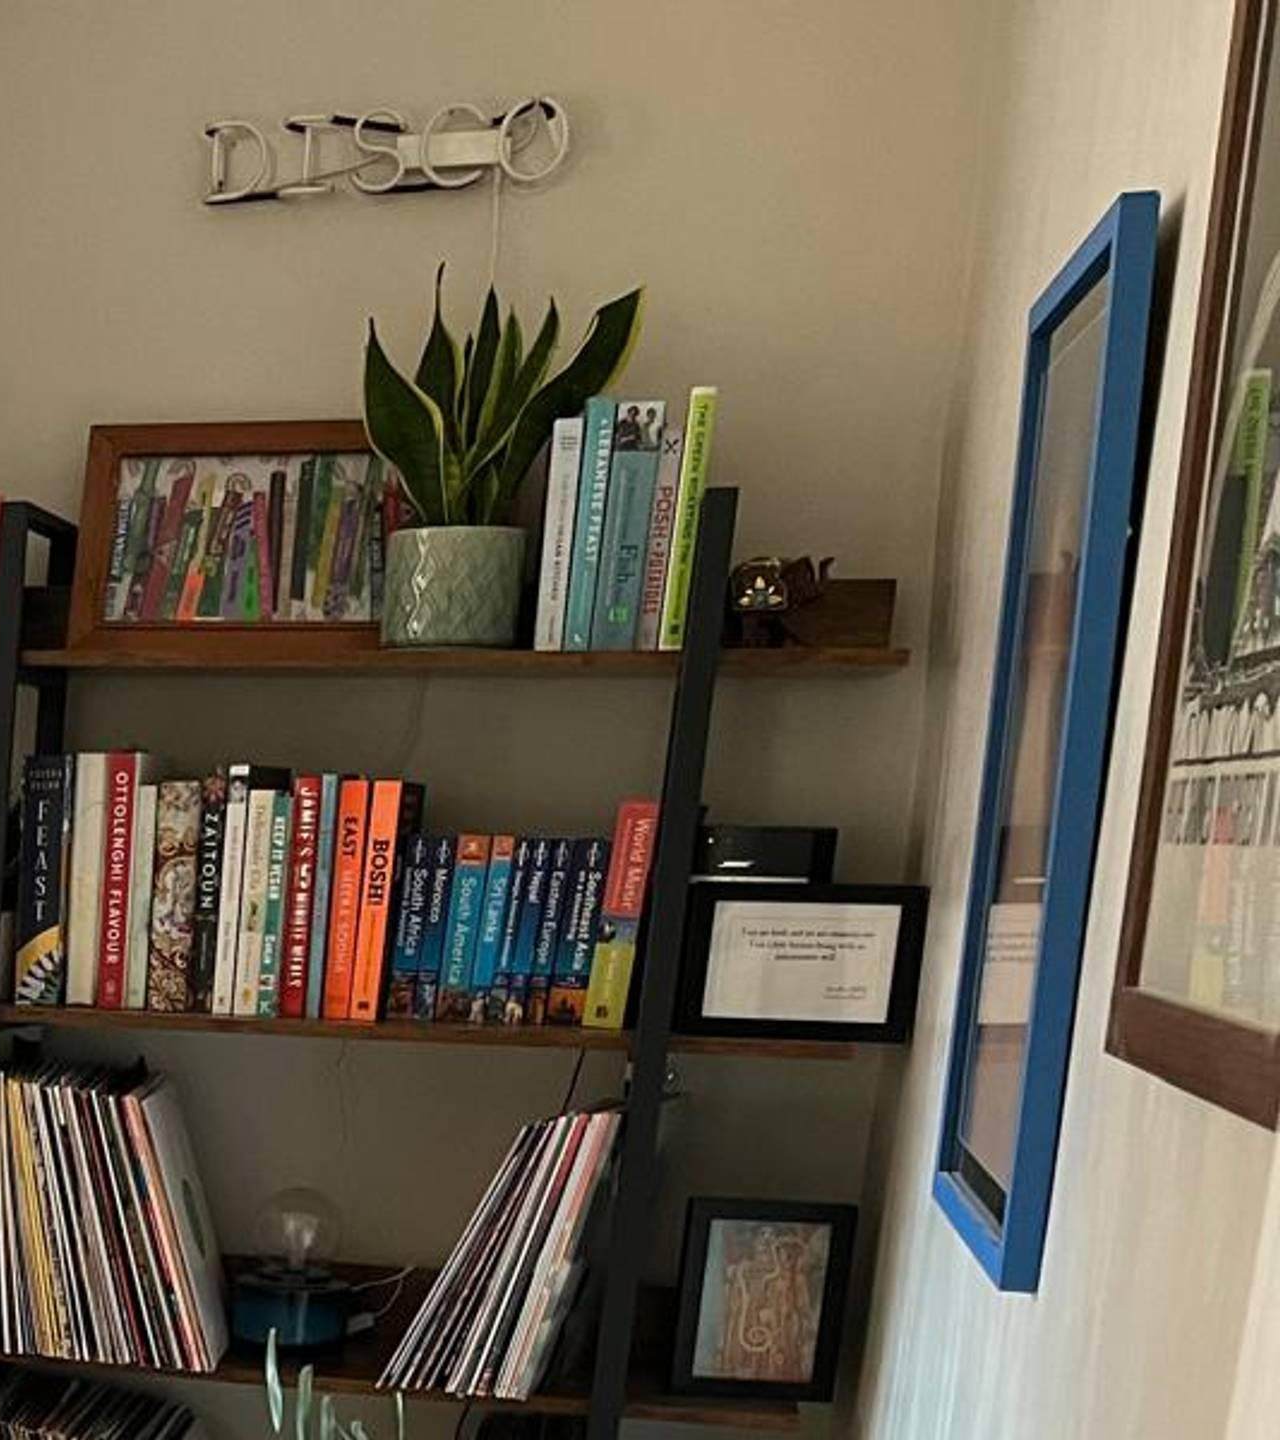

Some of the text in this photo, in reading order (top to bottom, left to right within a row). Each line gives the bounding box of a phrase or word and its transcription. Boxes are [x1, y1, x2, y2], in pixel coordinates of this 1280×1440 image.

[203, 97, 569, 204] DISCO
[590, 429, 612, 509] LEBANESE
[585, 514, 602, 562] FEAST
[616, 544, 638, 584] Fish
[643, 486, 675, 614] POSH POTATOES
[273, 815, 286, 847] KEEP
[299, 786, 319, 857] JAMIE'S
[342, 815, 359, 859] EAST
[630, 818, 656, 863] World
[33, 799, 50, 922] FEAST
[106, 771, 130, 965] OTTOLENGHI FLAVOUR
[200, 812, 220, 910] ZAITOUN
[268, 864, 282, 900] VEGAN
[410, 867, 429, 911] South
[527, 871, 546, 903] Nepal
[621, 867, 644, 910] Music
[429, 867, 448, 923] Morocco
[483, 877, 508, 943] Sri Lanka
[537, 870, 564, 965] Eastern Europe
[571, 871, 603, 971] Southeast Asia
[404, 914, 423, 957] Africa
[447, 877, 478, 986] South America
